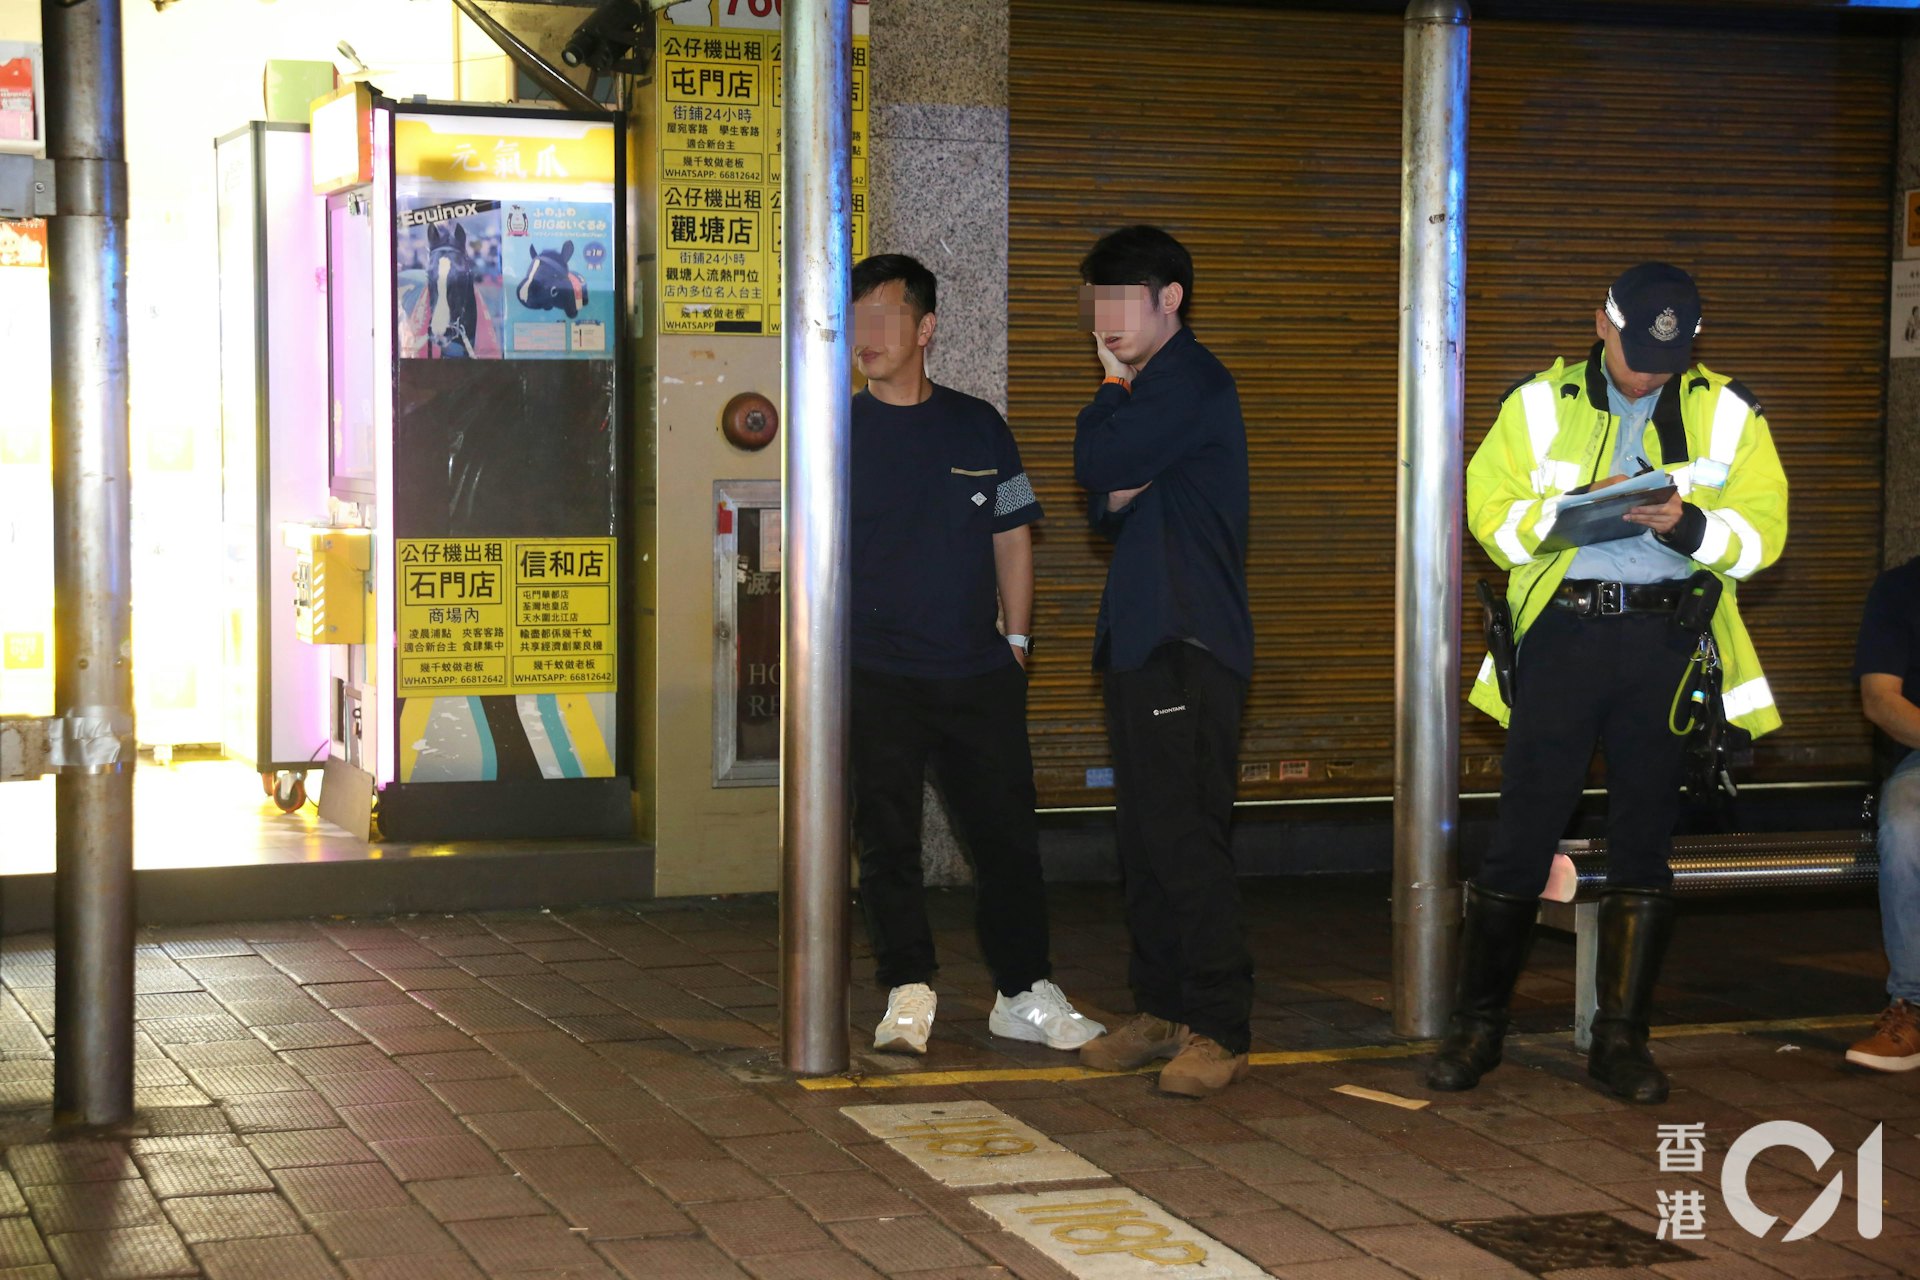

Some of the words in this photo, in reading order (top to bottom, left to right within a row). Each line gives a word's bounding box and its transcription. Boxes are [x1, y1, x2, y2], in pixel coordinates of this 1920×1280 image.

[664, 37, 762, 61] 公仔機出租
[671, 67, 753, 98] 屯門店
[673, 106, 752, 123] 街鋪24小時
[719, 125, 760, 137] 學生客路
[687, 139, 735, 150] 適合新台主
[450, 139, 569, 178] 元氣爪
[683, 156, 744, 168] 幾千蚊做老板
[665, 169, 717, 179] WHATSAPP:
[719, 170, 760, 180] 66812642
[664, 187, 762, 210] 公仔機出租
[400, 203, 478, 227] Equinox
[671, 215, 753, 245] 觀塘店
[680, 252, 746, 265] 街鋪24小時
[666, 267, 759, 283] 觀塘人流熱門位
[664, 285, 762, 299] 店內多位名人台主
[401, 543, 504, 563] 公仔機出租
[520, 551, 604, 577] 信和店
[410, 571, 495, 598] 石門店
[523, 590, 569, 599] 屯門華都店
[429, 607, 479, 624] 商場內
[523, 613, 578, 622] 天水圍北江店
[520, 628, 592, 639] 輸盡都係幾千蚊
[404, 641, 457, 653] 適合新台主
[462, 641, 504, 651] 食肆集中
[520, 641, 603, 652] 共享經濟創業良機
[420, 661, 484, 672] 幾千蚊做老板
[533, 659, 595, 670] 幾千蚊做老板
[404, 676, 457, 685] WHATSAPP:
[460, 675, 503, 683] 66812642
[515, 674, 567, 682] WHATSAPP:
[570, 673, 611, 681] 66812642
